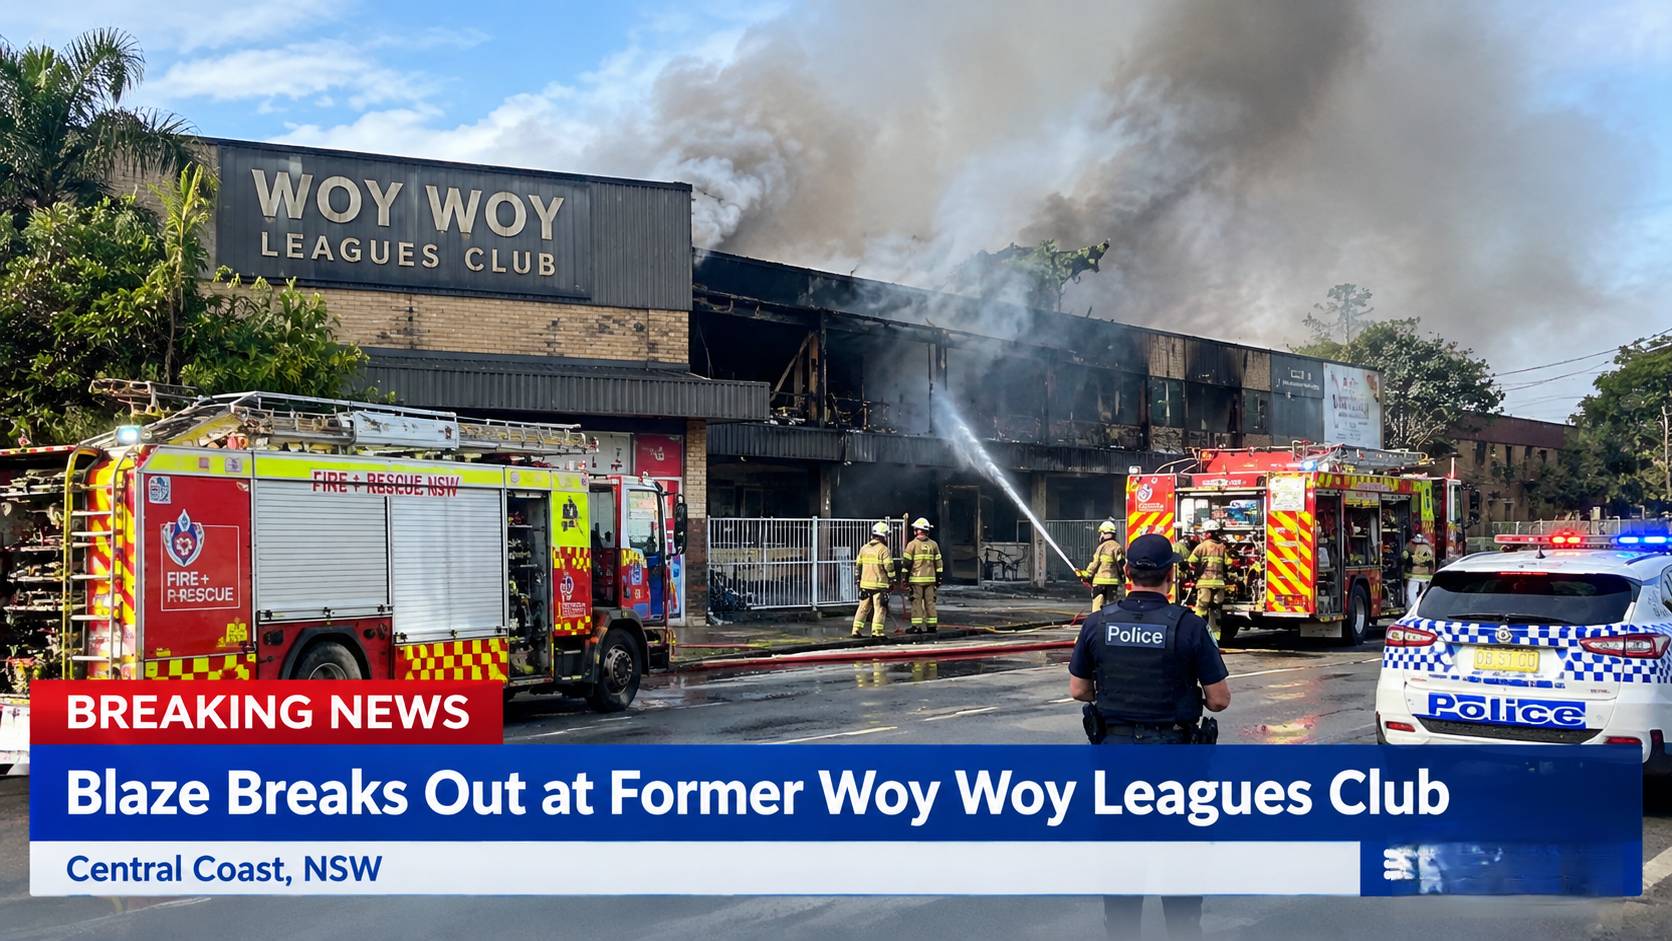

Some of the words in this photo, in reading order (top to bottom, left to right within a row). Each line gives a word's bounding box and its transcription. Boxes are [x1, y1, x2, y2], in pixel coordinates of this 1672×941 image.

[251, 168, 403, 227] WOY
[425, 184, 565, 241] WOY
[261, 231, 439, 269] LEAGUES
[464, 246, 557, 277] CLUB
[312, 471, 348, 493] FIRE
[367, 472, 424, 496] RESCUE
[428, 476, 460, 497] NSW
[1107, 625, 1163, 644] Police
[1431, 693, 1586, 727] Police
